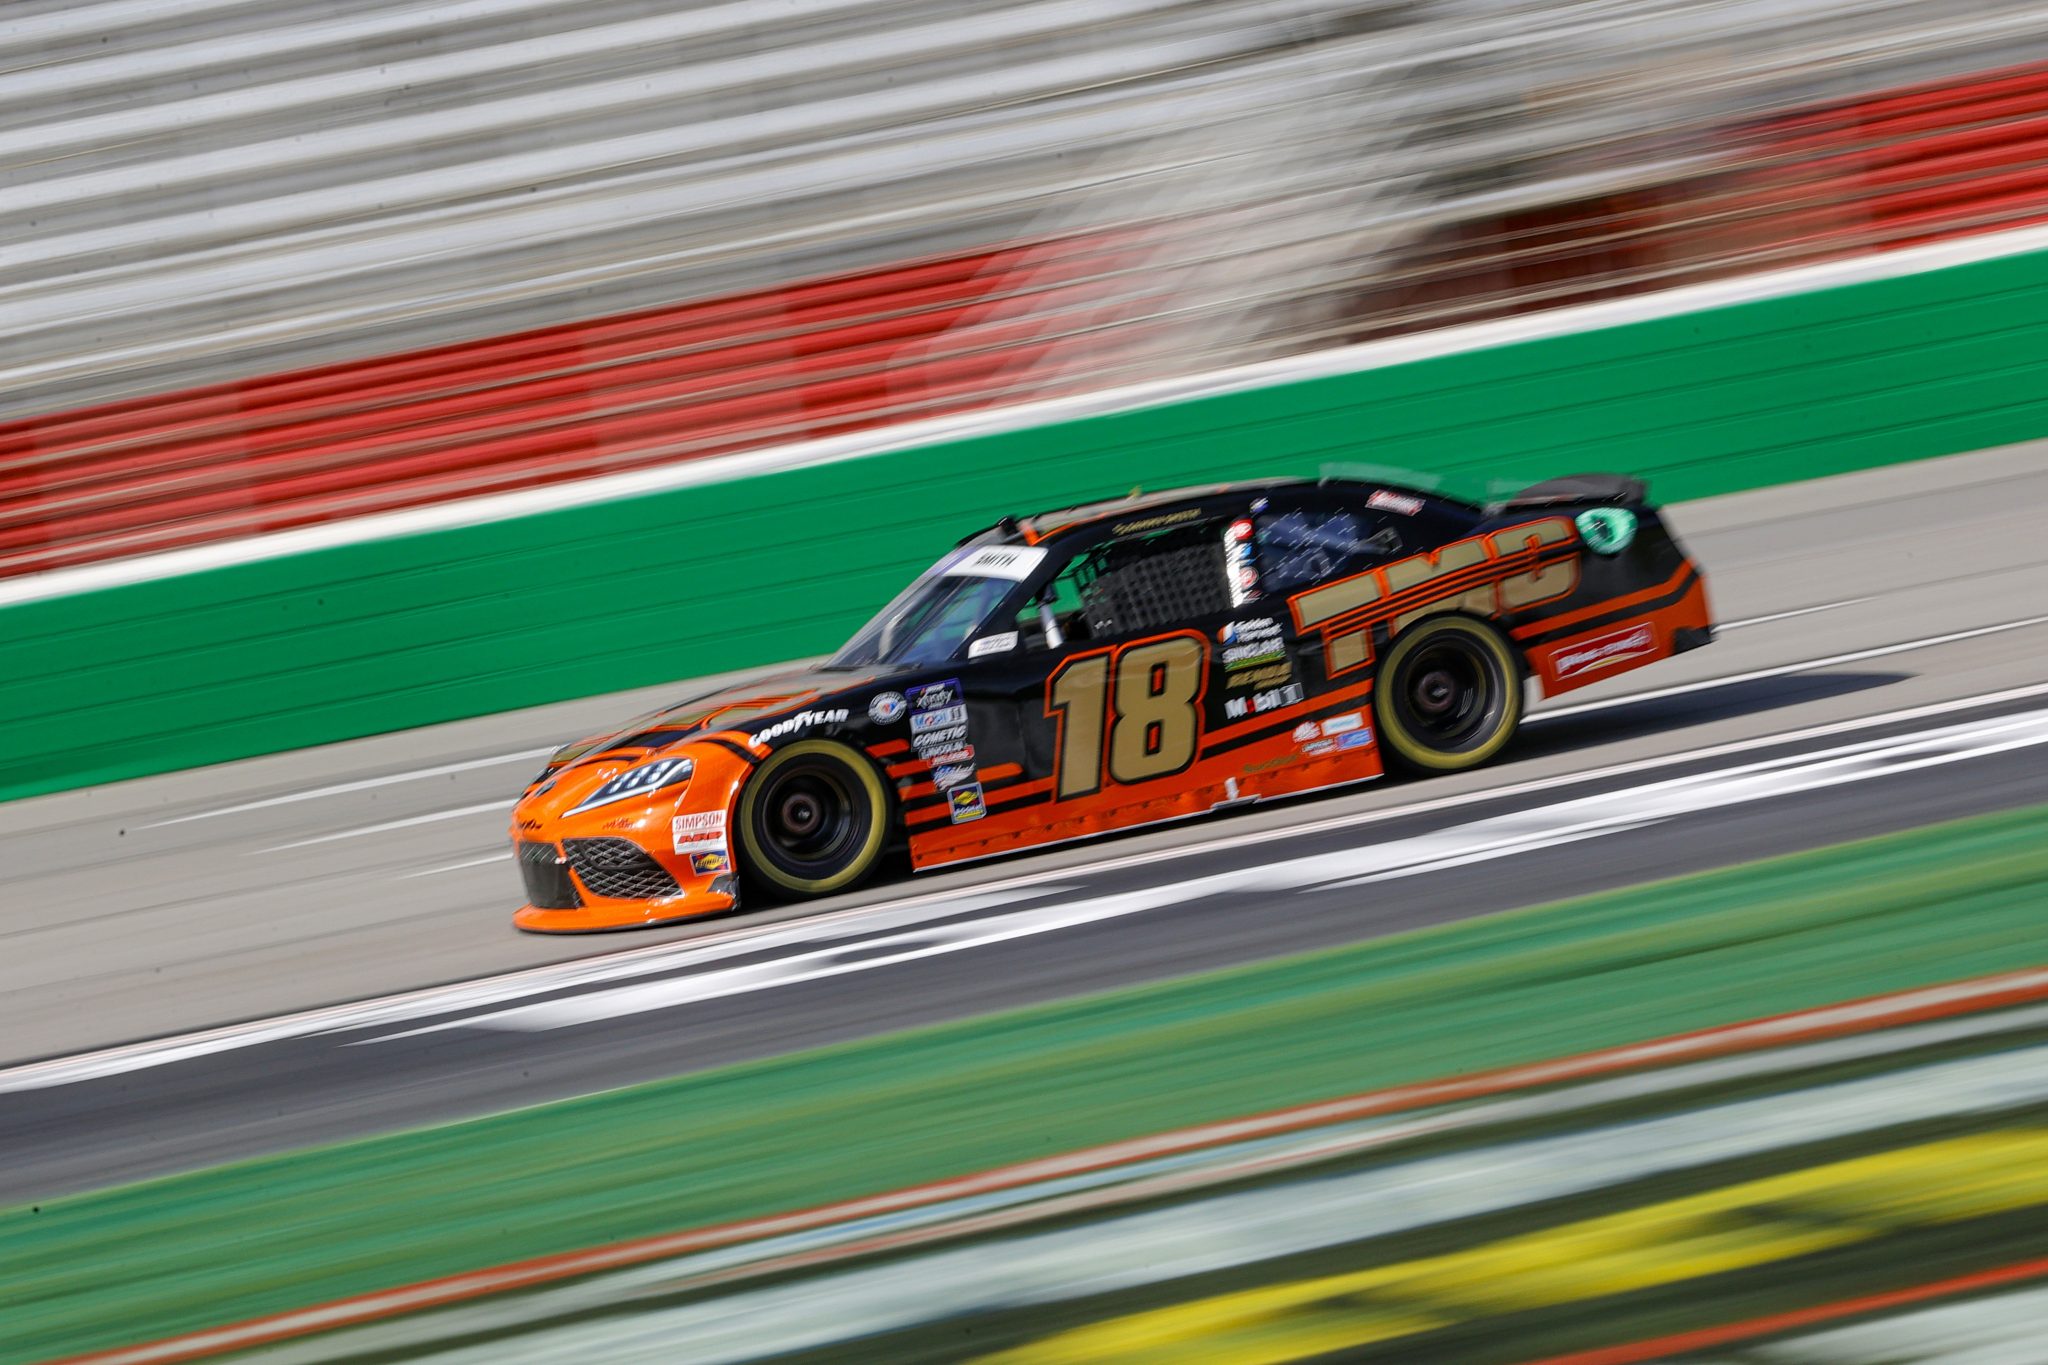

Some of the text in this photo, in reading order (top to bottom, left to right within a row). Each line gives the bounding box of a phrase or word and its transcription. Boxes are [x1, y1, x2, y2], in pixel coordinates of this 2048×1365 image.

[972, 551, 1020, 569] SMITH
[1045, 630, 1210, 802] 18
[747, 709, 849, 749] GOODYEAR
[913, 725, 966, 748] COMETIC
[675, 812, 723, 831] SIMPSON
